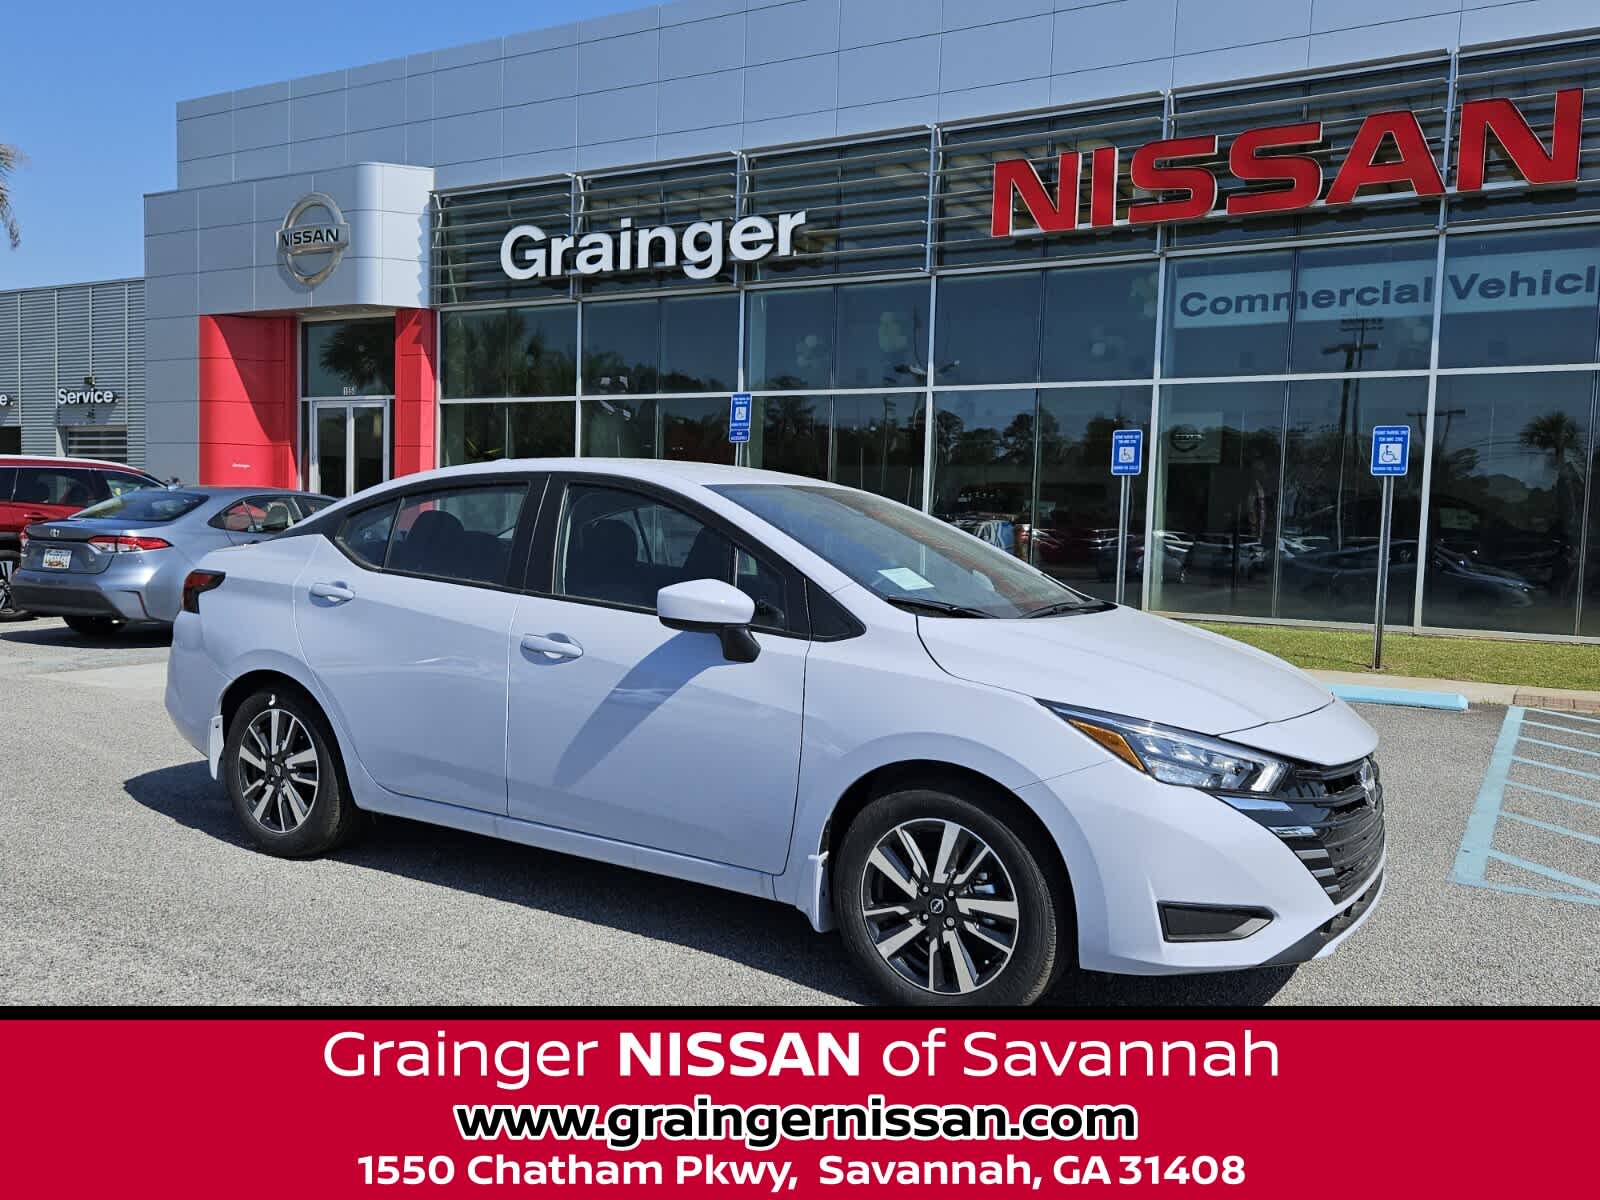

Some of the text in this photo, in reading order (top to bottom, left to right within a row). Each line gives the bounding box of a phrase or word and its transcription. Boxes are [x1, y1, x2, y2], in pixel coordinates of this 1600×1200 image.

[991, 88, 1584, 237] NISSAN
[281, 228, 339, 247] NISSAN
[500, 210, 806, 280] Grainger
[1180, 276, 1433, 317] Commercial
[58, 388, 114, 405] Service
